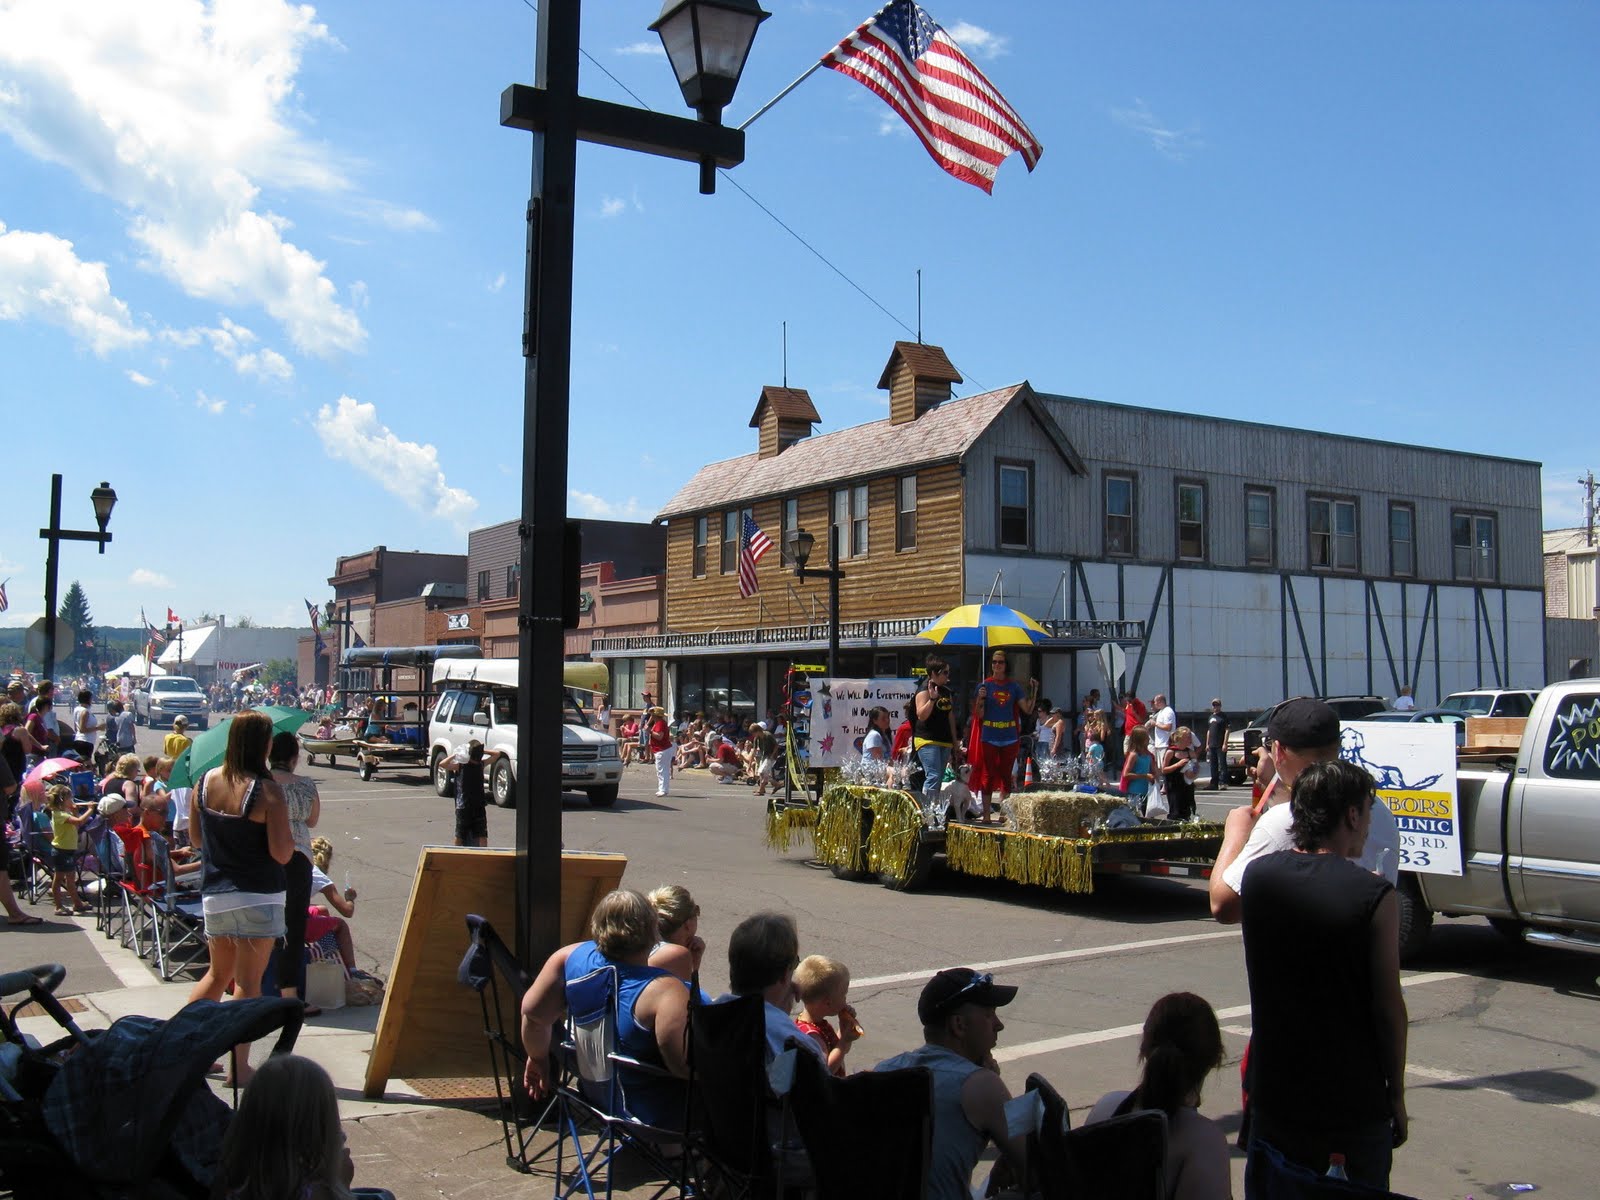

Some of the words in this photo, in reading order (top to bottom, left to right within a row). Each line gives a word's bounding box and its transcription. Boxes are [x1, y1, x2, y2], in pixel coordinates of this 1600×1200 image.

[218, 662, 239, 670] NOW
[864, 689, 874, 699] DO
[860, 707, 870, 718] OU
[1571, 717, 1600, 750] PO
[1394, 817, 1450, 833] LINIC
[1421, 837, 1448, 850] RD.
